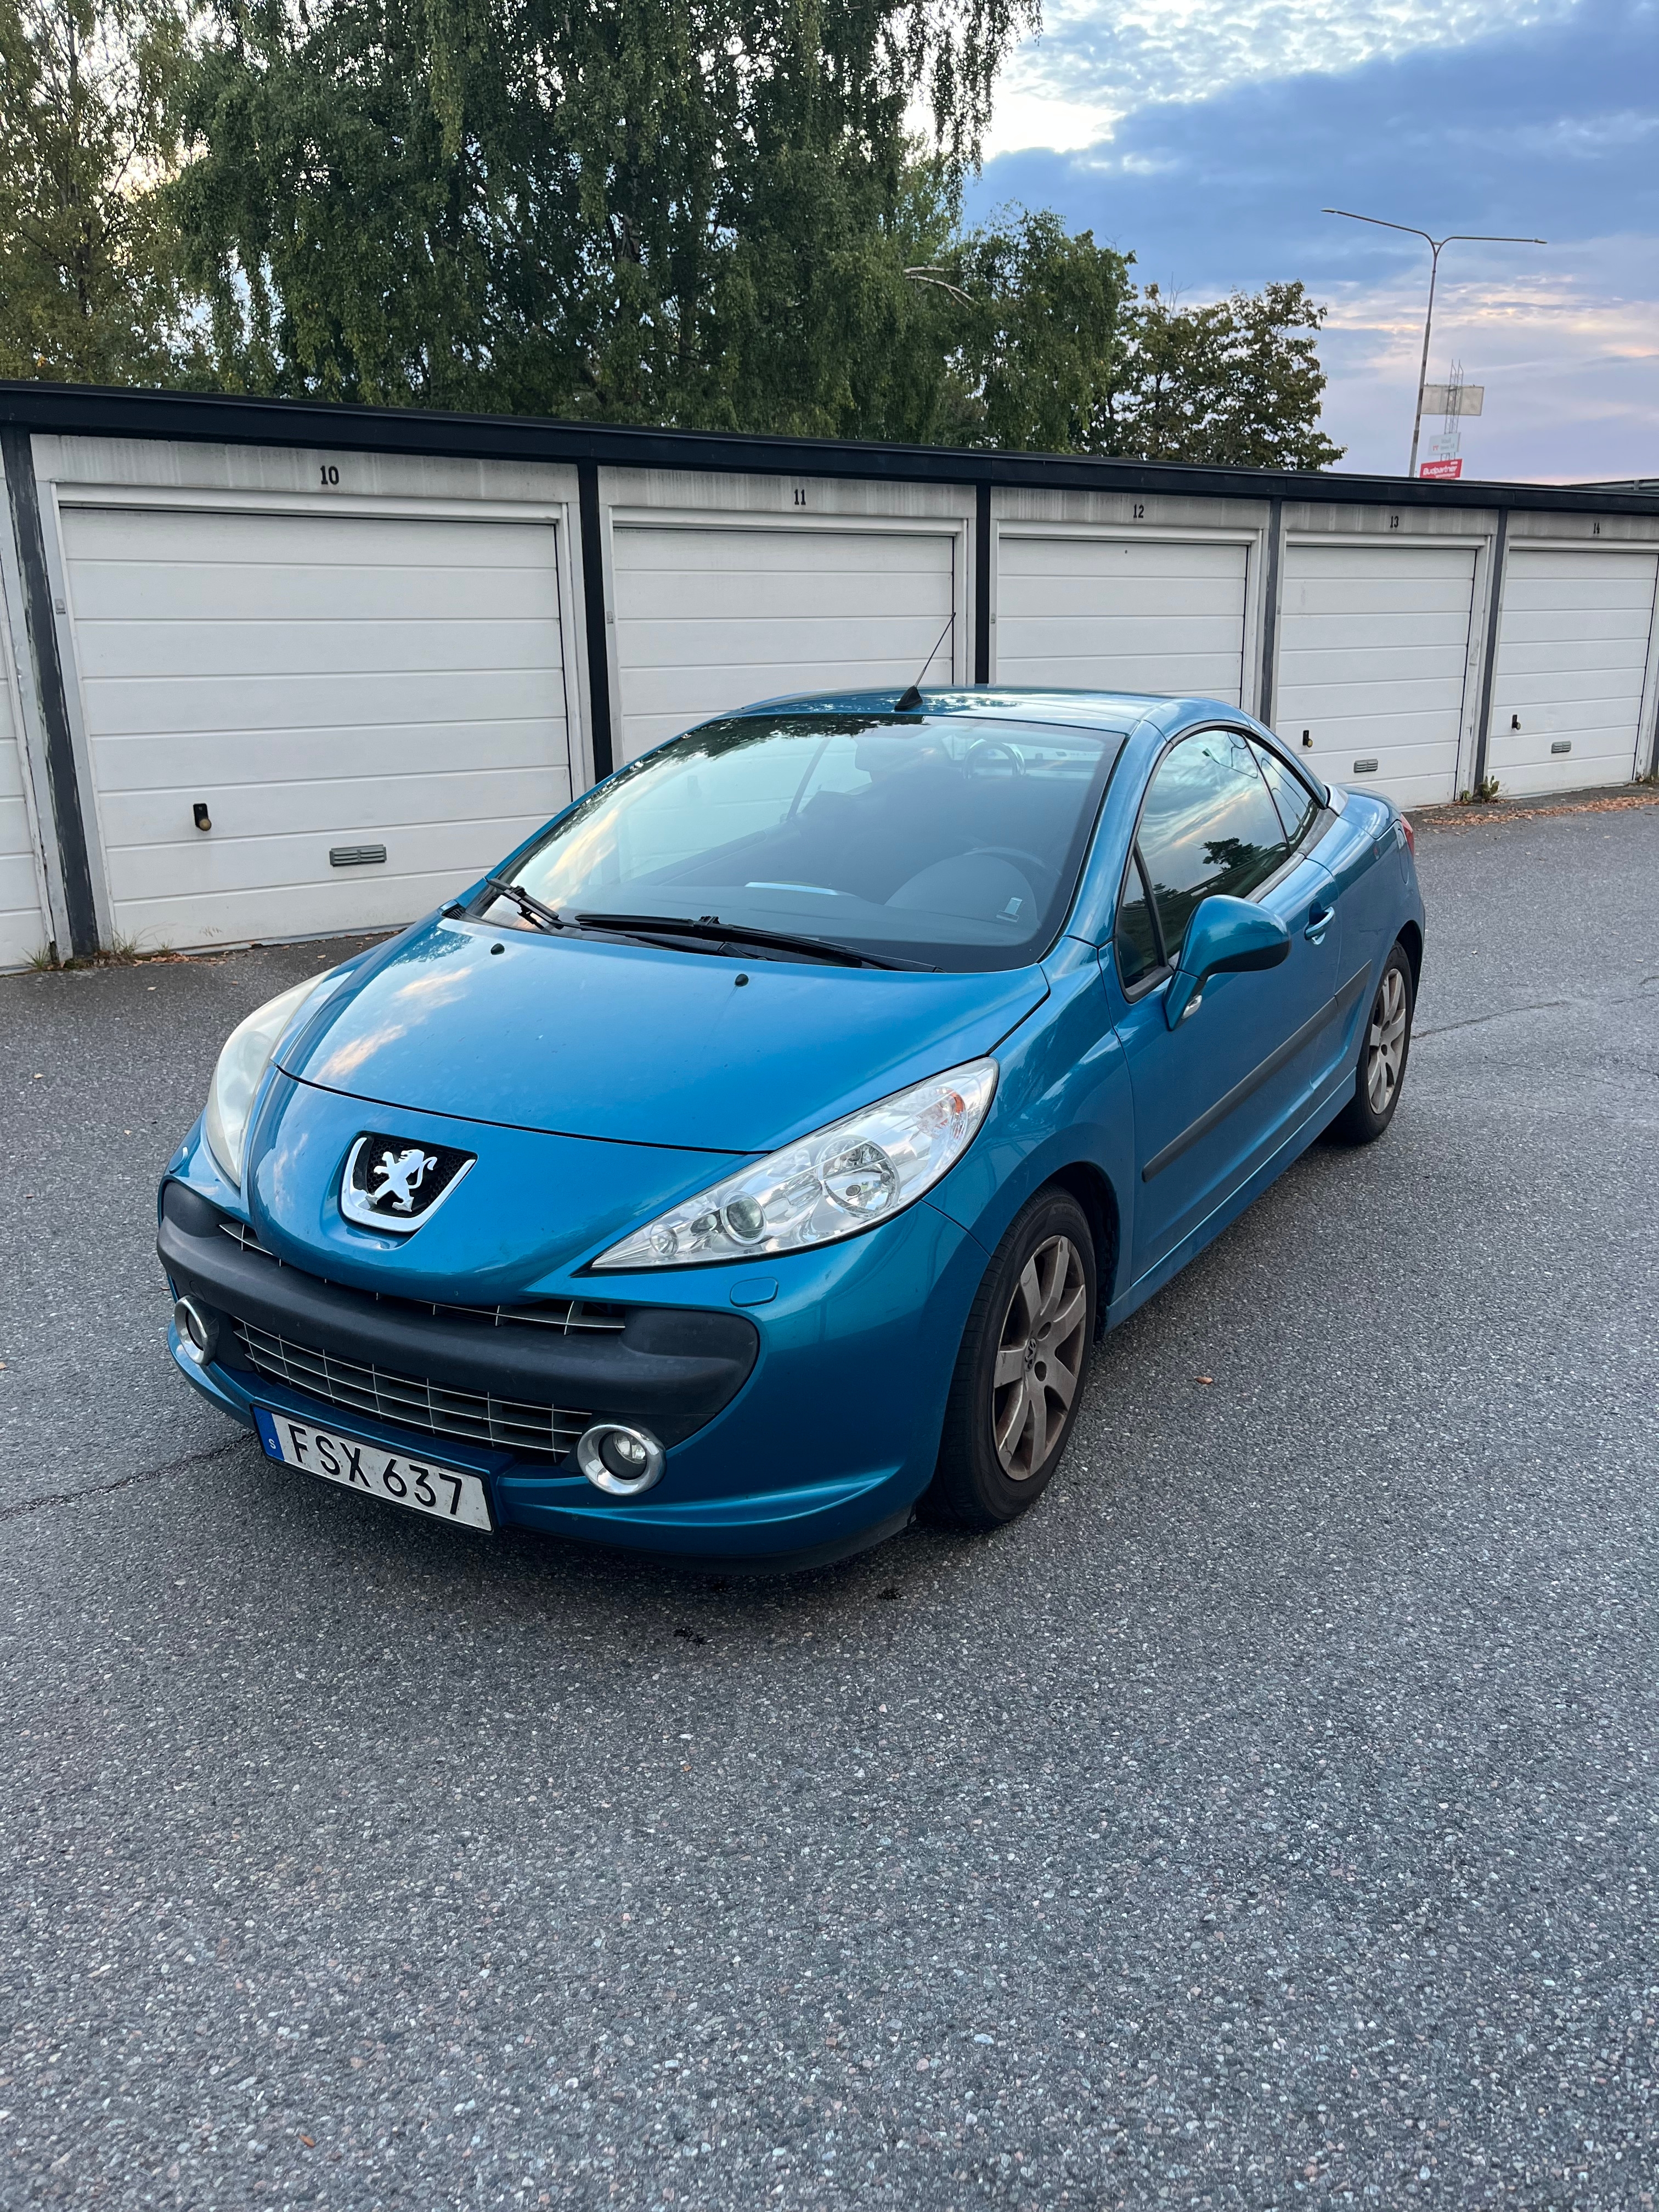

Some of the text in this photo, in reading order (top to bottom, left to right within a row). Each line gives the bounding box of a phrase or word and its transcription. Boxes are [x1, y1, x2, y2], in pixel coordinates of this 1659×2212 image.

[320, 465, 339, 485] 10
[794, 489, 806, 505] 11
[1133, 504, 1144, 518] 12
[1390, 516, 1399, 528] 13
[1593, 522, 1600, 534] 14
[269, 1438, 276, 1449] S
[288, 1423, 462, 1515] FSX 637
